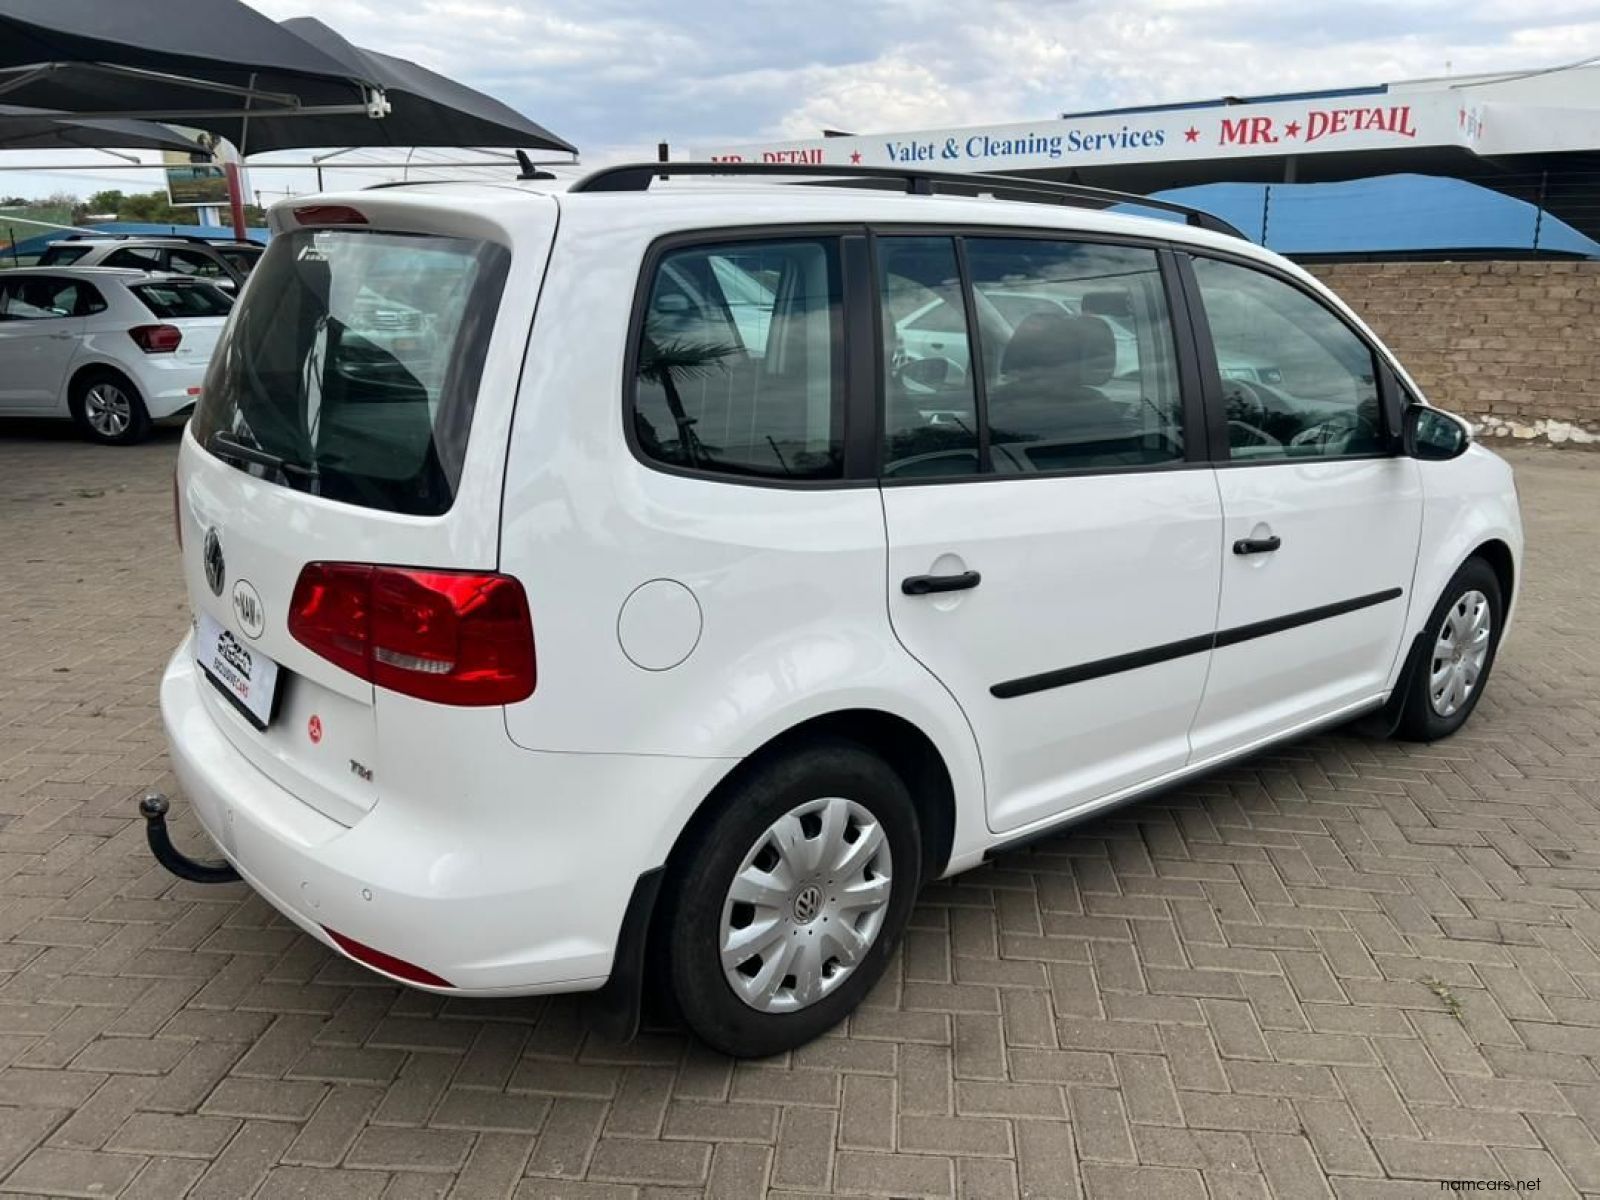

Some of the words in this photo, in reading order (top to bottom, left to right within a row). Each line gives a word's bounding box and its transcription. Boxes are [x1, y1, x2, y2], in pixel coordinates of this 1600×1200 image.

[886, 139, 934, 162] Valet
[941, 138, 960, 160] &
[965, 132, 1062, 159] Cleaning
[1067, 126, 1165, 152] Services
[1219, 117, 1278, 145] MR.
[1305, 106, 1417, 142] DETAIL
